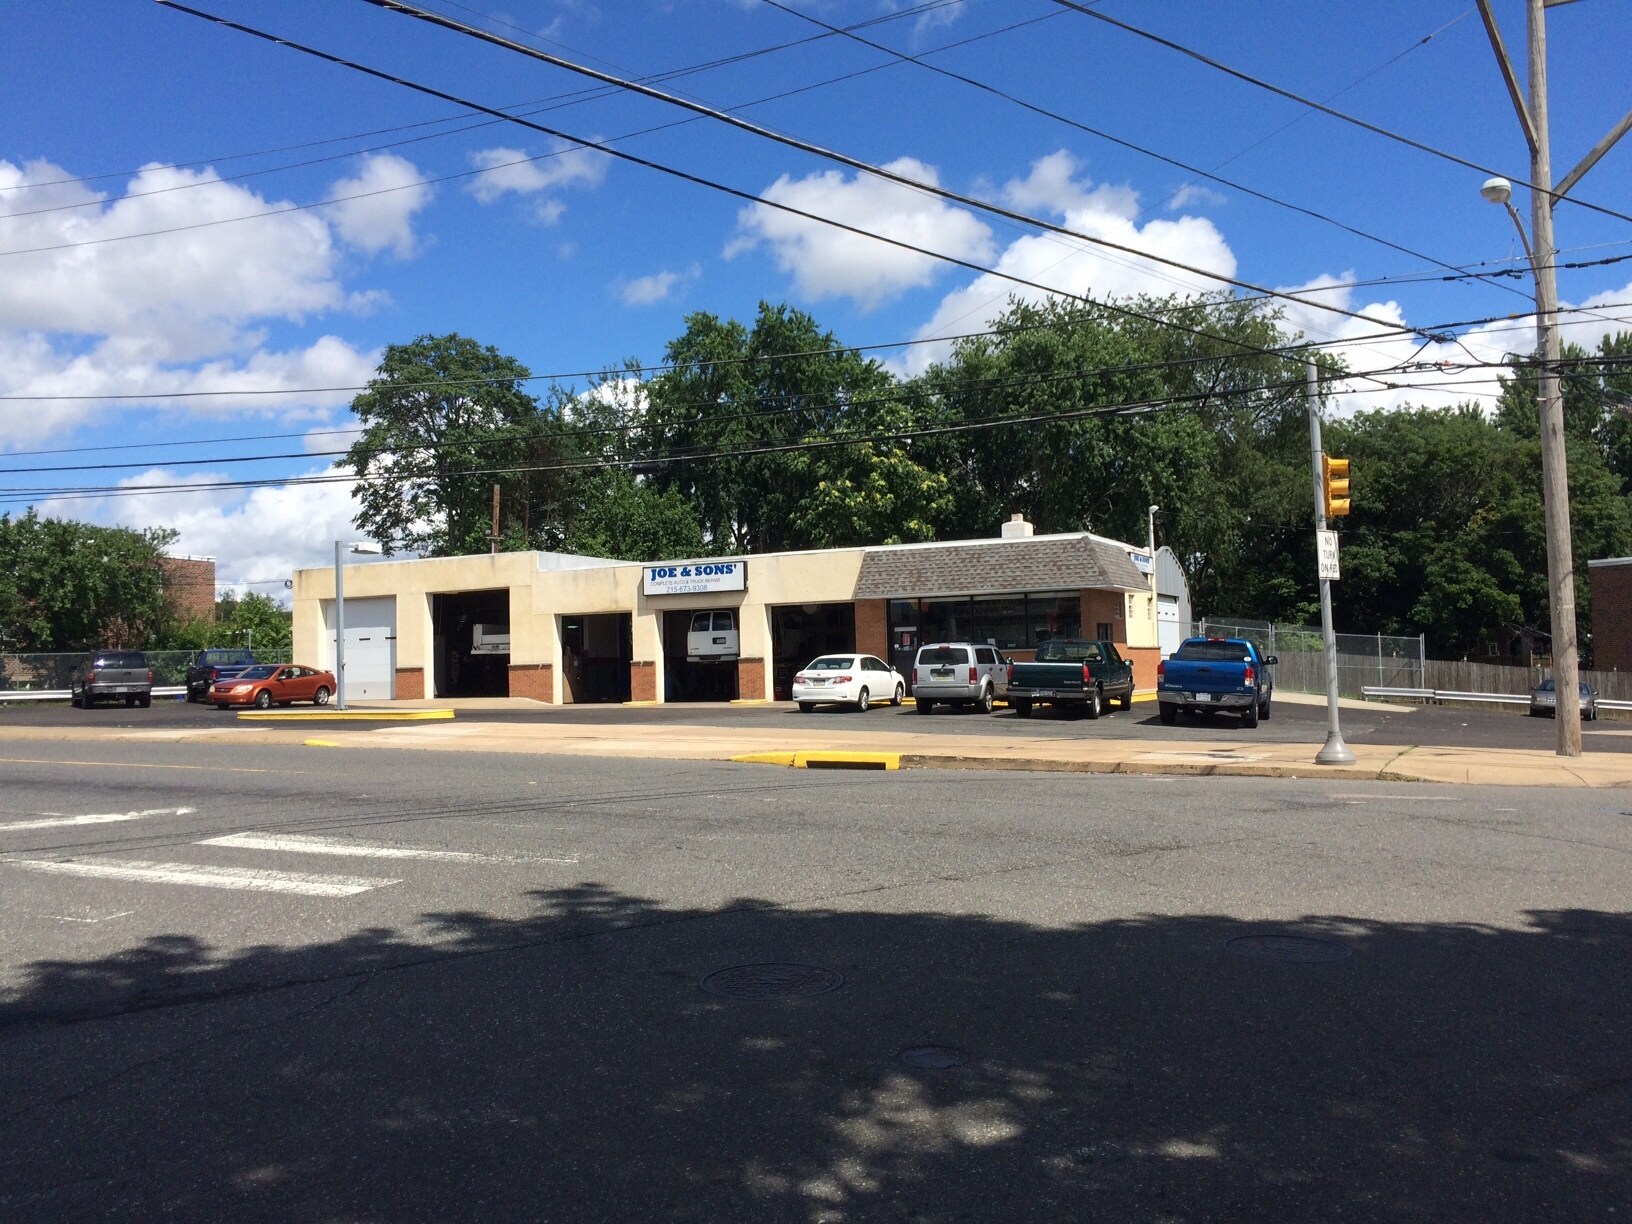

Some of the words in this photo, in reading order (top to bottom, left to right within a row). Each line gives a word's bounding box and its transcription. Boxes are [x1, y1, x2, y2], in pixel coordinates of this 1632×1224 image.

[1324, 536, 1333, 546] NO
[1322, 550, 1336, 560] TURN
[1321, 563, 1329, 573] ON
[651, 568, 677, 581] JOE
[680, 567, 691, 577] &
[666, 585, 708, 593] 215-673-9308
